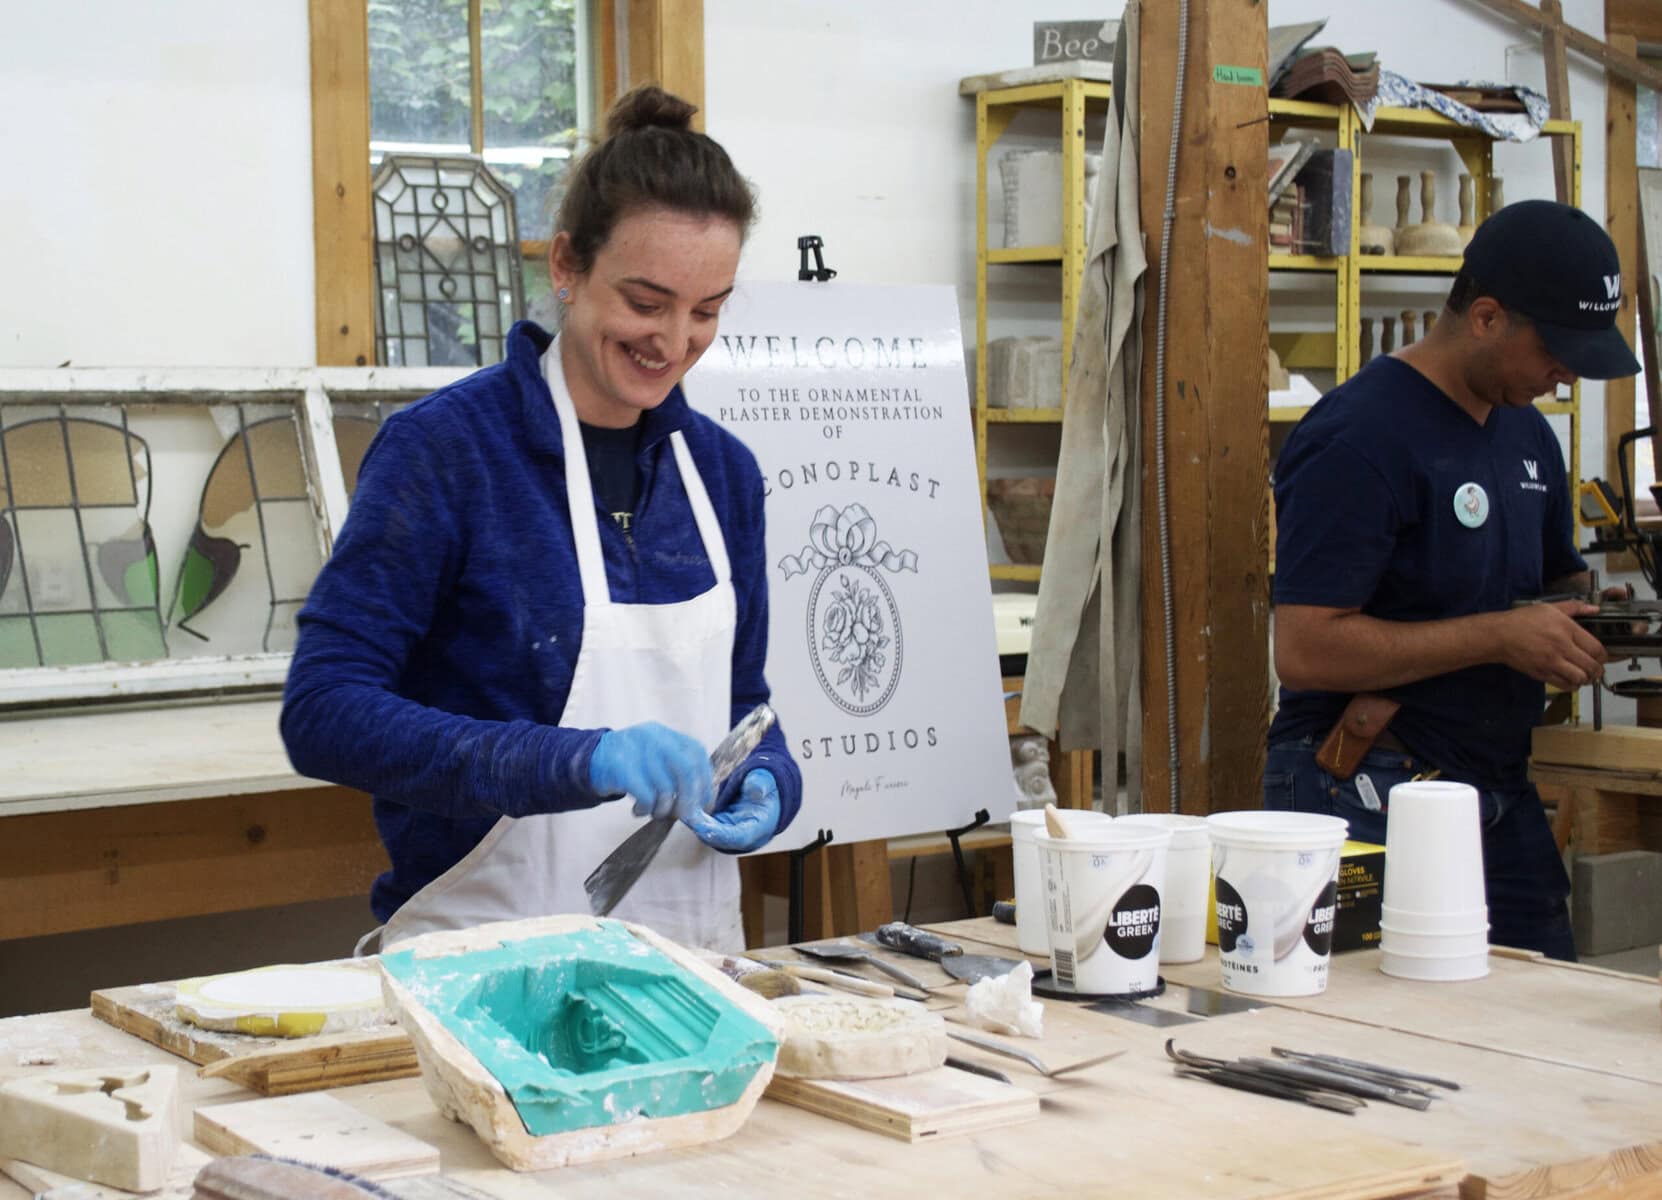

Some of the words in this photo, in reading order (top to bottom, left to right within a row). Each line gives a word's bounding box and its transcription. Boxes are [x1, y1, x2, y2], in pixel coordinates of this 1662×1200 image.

[1041, 29, 1099, 60] Bee
[720, 335, 928, 369] WELCOME
[738, 388, 761, 402] TO
[768, 388, 800, 402] THE
[808, 388, 922, 402] ORNAMENTAL
[720, 407, 792, 421] PLASTER
[800, 406, 943, 421] DEMONSTRATION
[823, 425, 843, 439] OF
[761, 460, 941, 500] CONOPLAST
[802, 726, 938, 760] STUDIOS
[1109, 904, 1159, 927] LIBERTÉ
[1117, 924, 1153, 938] GREEK
